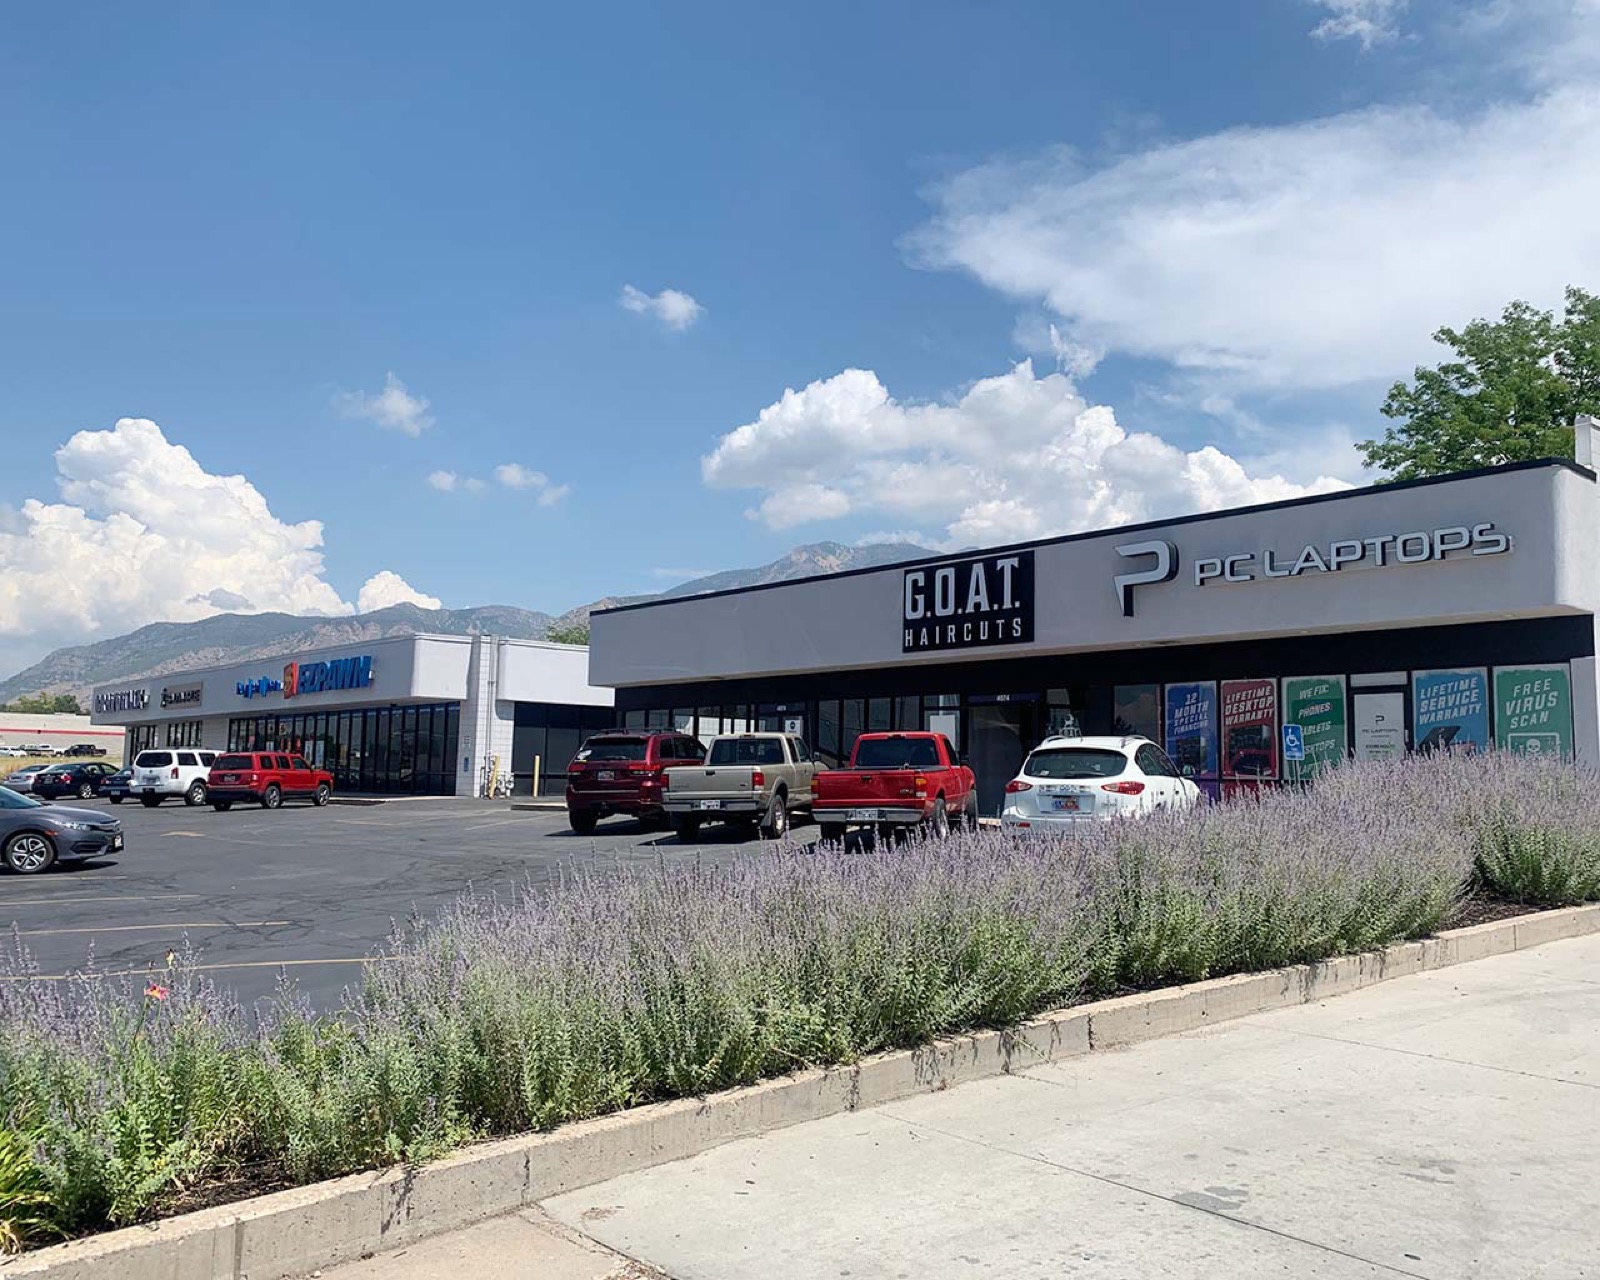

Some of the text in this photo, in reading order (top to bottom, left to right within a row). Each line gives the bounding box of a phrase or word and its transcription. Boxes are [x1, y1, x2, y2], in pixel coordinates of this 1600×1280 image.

[1194, 522, 1511, 587] PC LAPTOPS
[905, 556, 1020, 620] G.O.A.T.
[904, 617, 1021, 647] HAIRCUTS
[1226, 686, 1272, 704] LIFETIME
[1300, 684, 1330, 699] WE FIX
[1420, 677, 1478, 700] LIFETIME
[1513, 678, 1552, 698] FREE
[1185, 692, 1198, 705] 12
[1225, 696, 1273, 715] DESKTOP
[1420, 688, 1479, 713] SERVICE
[1505, 691, 1559, 716] VIRUS
[1174, 700, 1209, 720] MONTH
[1174, 712, 1208, 727] SPECIAL
[1225, 708, 1275, 725] WARRANTY
[1298, 702, 1331, 719] PHONES
[1419, 703, 1482, 725] WARRANTY
[1510, 711, 1549, 729] SCAN
